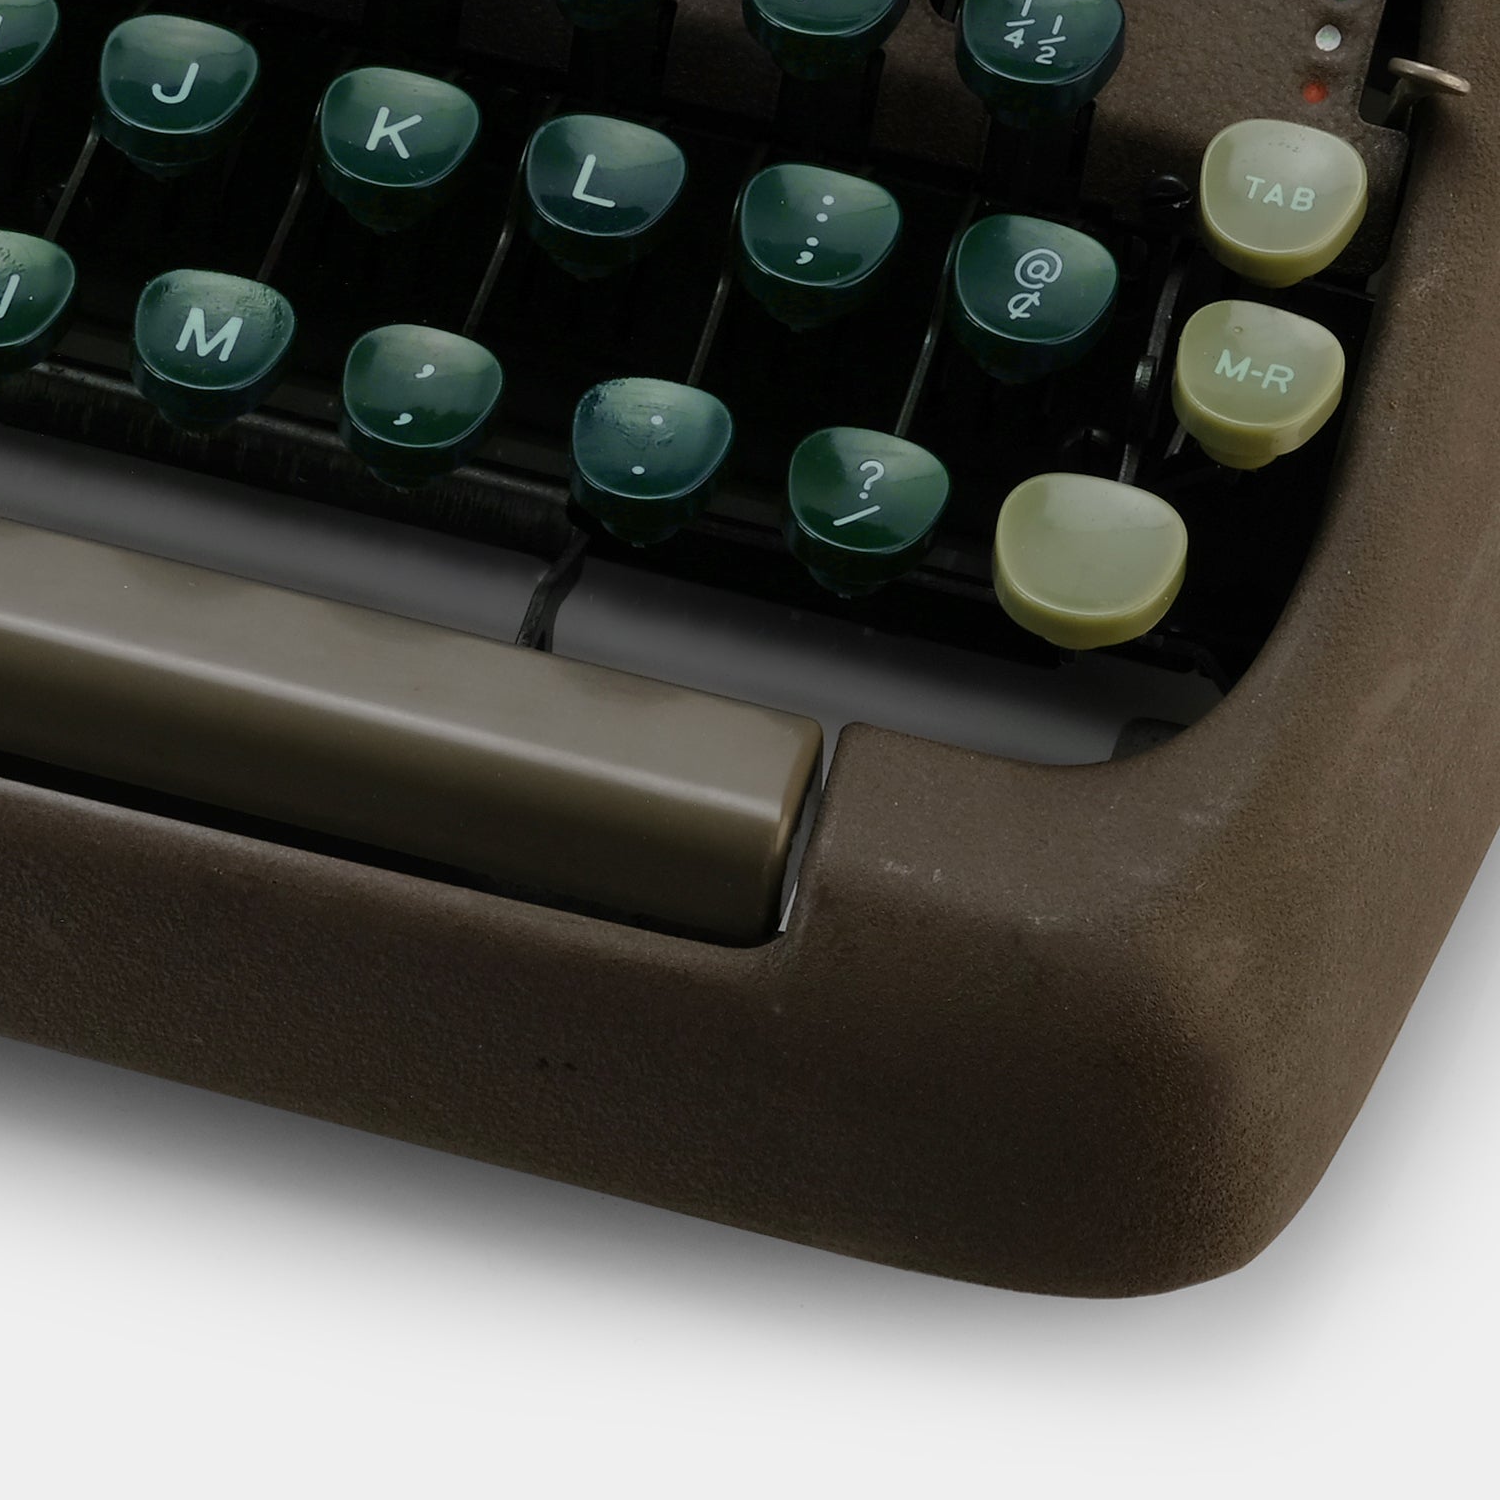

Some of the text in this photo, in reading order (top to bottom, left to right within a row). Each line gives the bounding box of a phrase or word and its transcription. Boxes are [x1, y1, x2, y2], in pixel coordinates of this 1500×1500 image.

[151, 59, 200, 104] J
[365, 106, 423, 159] K
[572, 150, 616, 208] L
[1244, 174, 1318, 212] TAB
[795, 236, 819, 265] ;
[1014, 248, 1063, 290] @
[1007, 291, 1041, 320] ¢
[175, 303, 244, 362] M
[1212, 346, 1296, 394] M-R
[859, 460, 885, 500] ?
[832, 504, 881, 526] /
